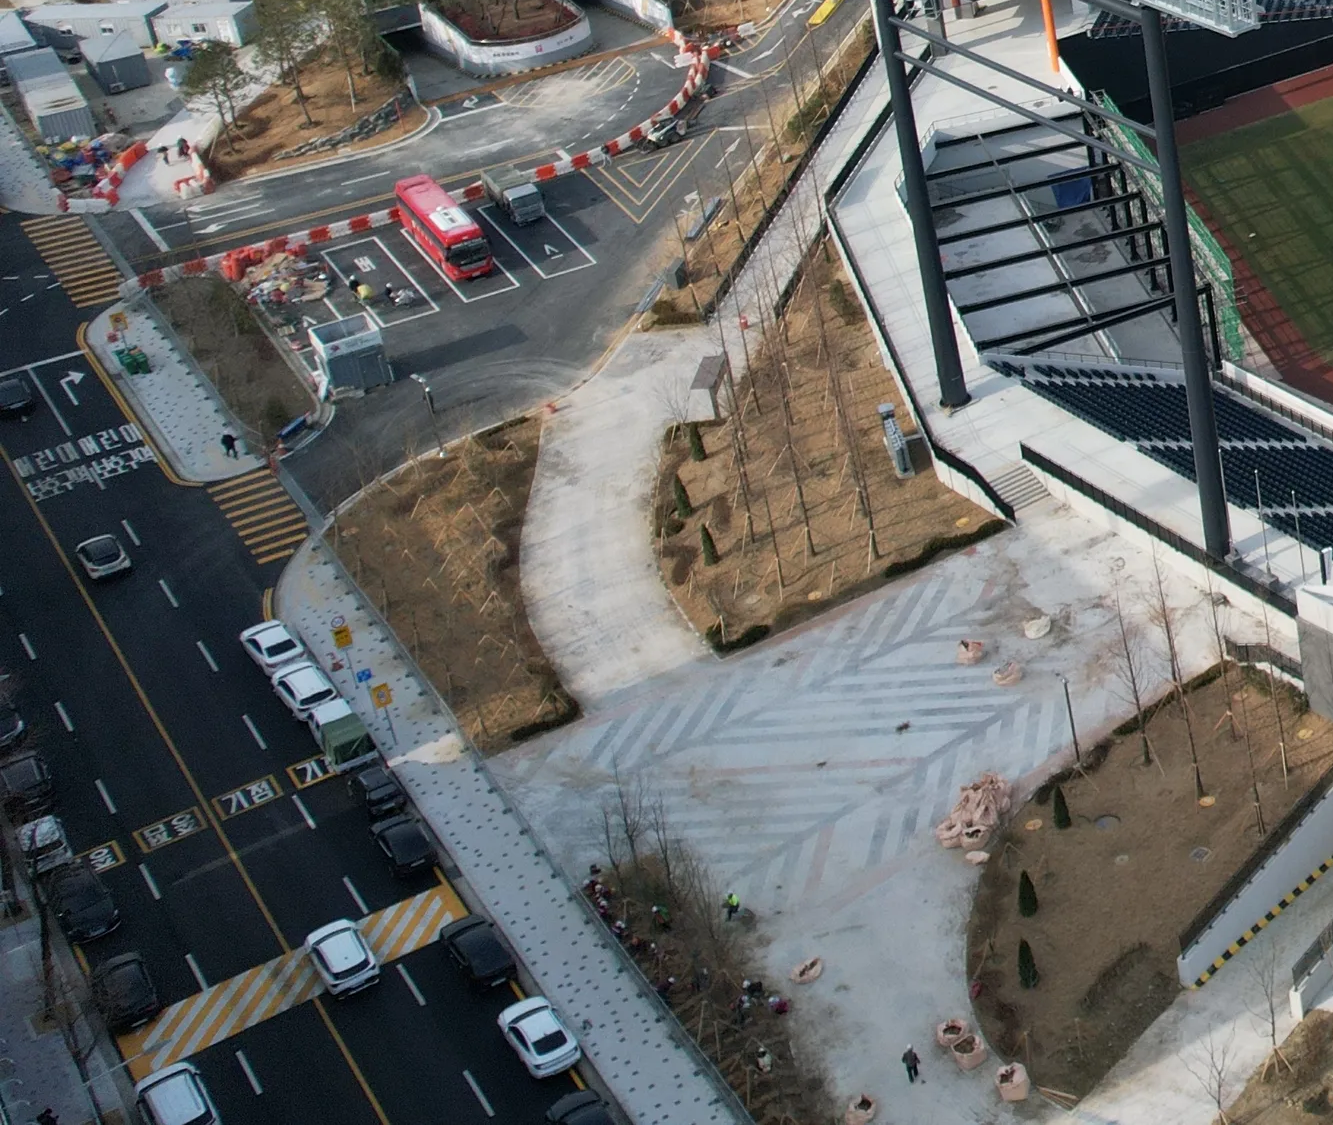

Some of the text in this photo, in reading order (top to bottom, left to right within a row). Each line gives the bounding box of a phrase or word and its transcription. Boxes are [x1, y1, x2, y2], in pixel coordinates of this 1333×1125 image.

[13, 423, 144, 478] 어린이 어린이
[26, 446, 158, 502] 보호구역 보호구역
[221, 779, 275, 815] 기점
